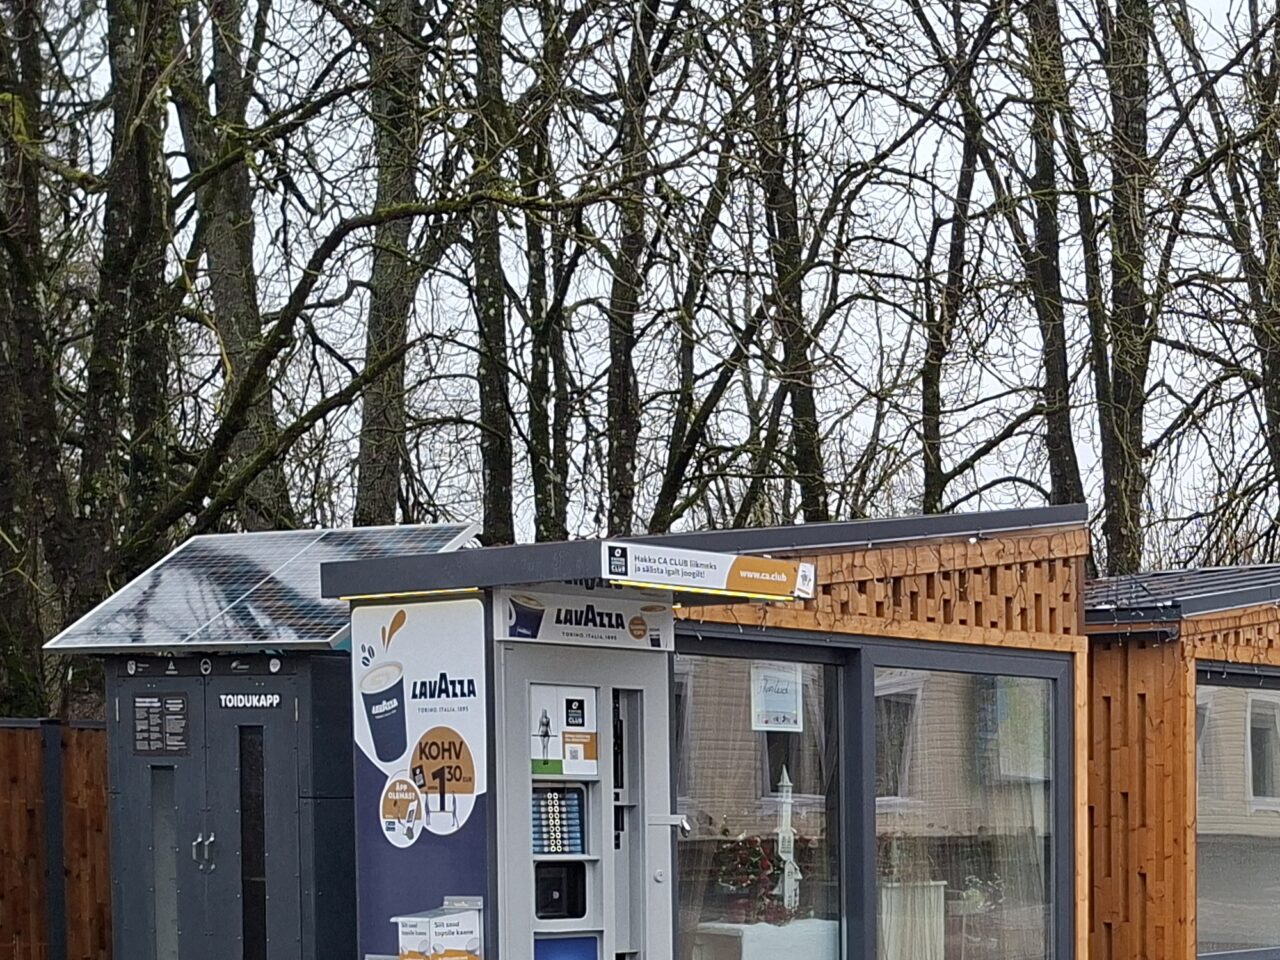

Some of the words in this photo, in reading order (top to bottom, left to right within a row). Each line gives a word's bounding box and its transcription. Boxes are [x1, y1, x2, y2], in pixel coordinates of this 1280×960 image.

[634, 554, 657, 566] Hakka
[657, 557, 668, 567] CA
[669, 558, 688, 568] CLUB
[555, 604, 625, 630] LAVAZZA
[411, 672, 477, 699] LAVAZZA
[219, 695, 280, 708] TOIDUKAPP
[418, 740, 463, 761] KOHV
[431, 765, 446, 811] 1
[446, 765, 463, 782] 30
